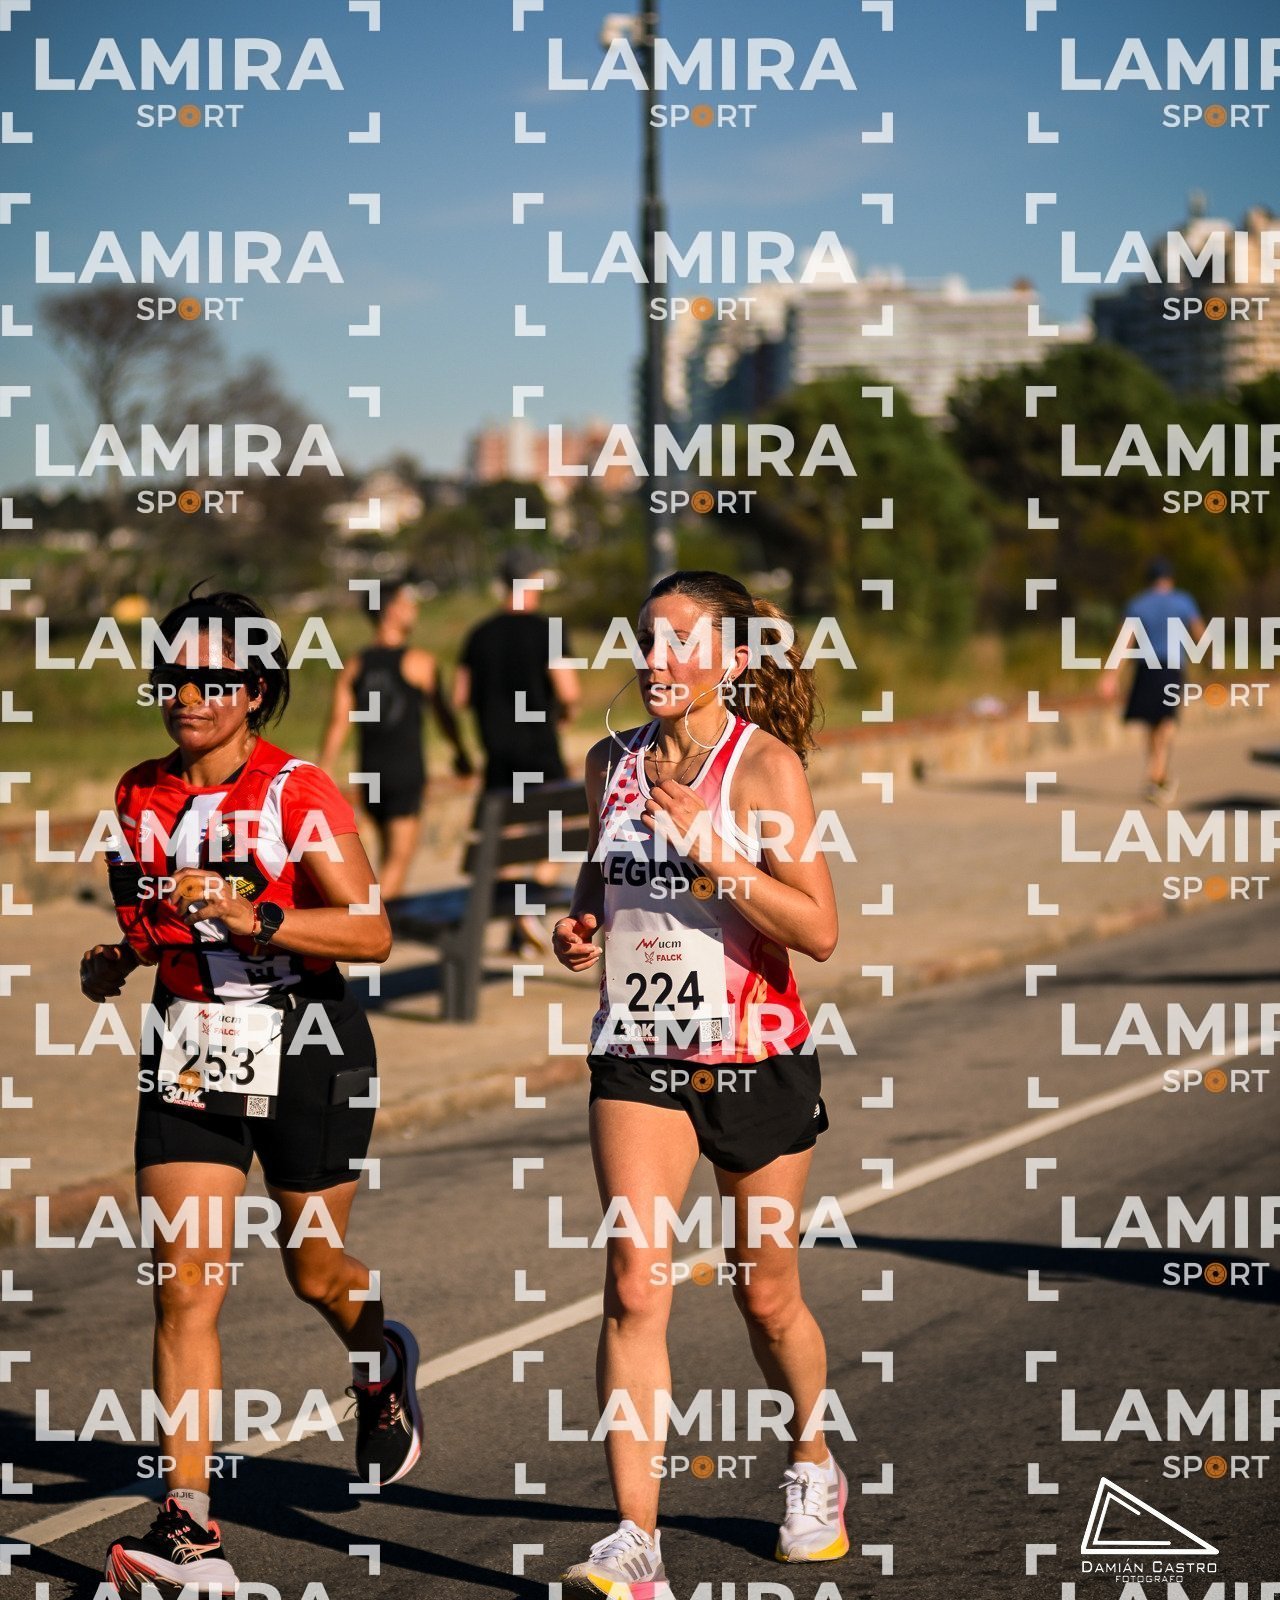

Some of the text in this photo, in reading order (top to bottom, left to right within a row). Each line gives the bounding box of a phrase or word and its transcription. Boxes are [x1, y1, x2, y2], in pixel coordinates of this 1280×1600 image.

[657, 940, 681, 949] ucm
[656, 953, 682, 962] FALCK
[625, 970, 705, 1012] 224
[178, 1040, 255, 1086] 253
[162, 1084, 203, 1104] 30K
